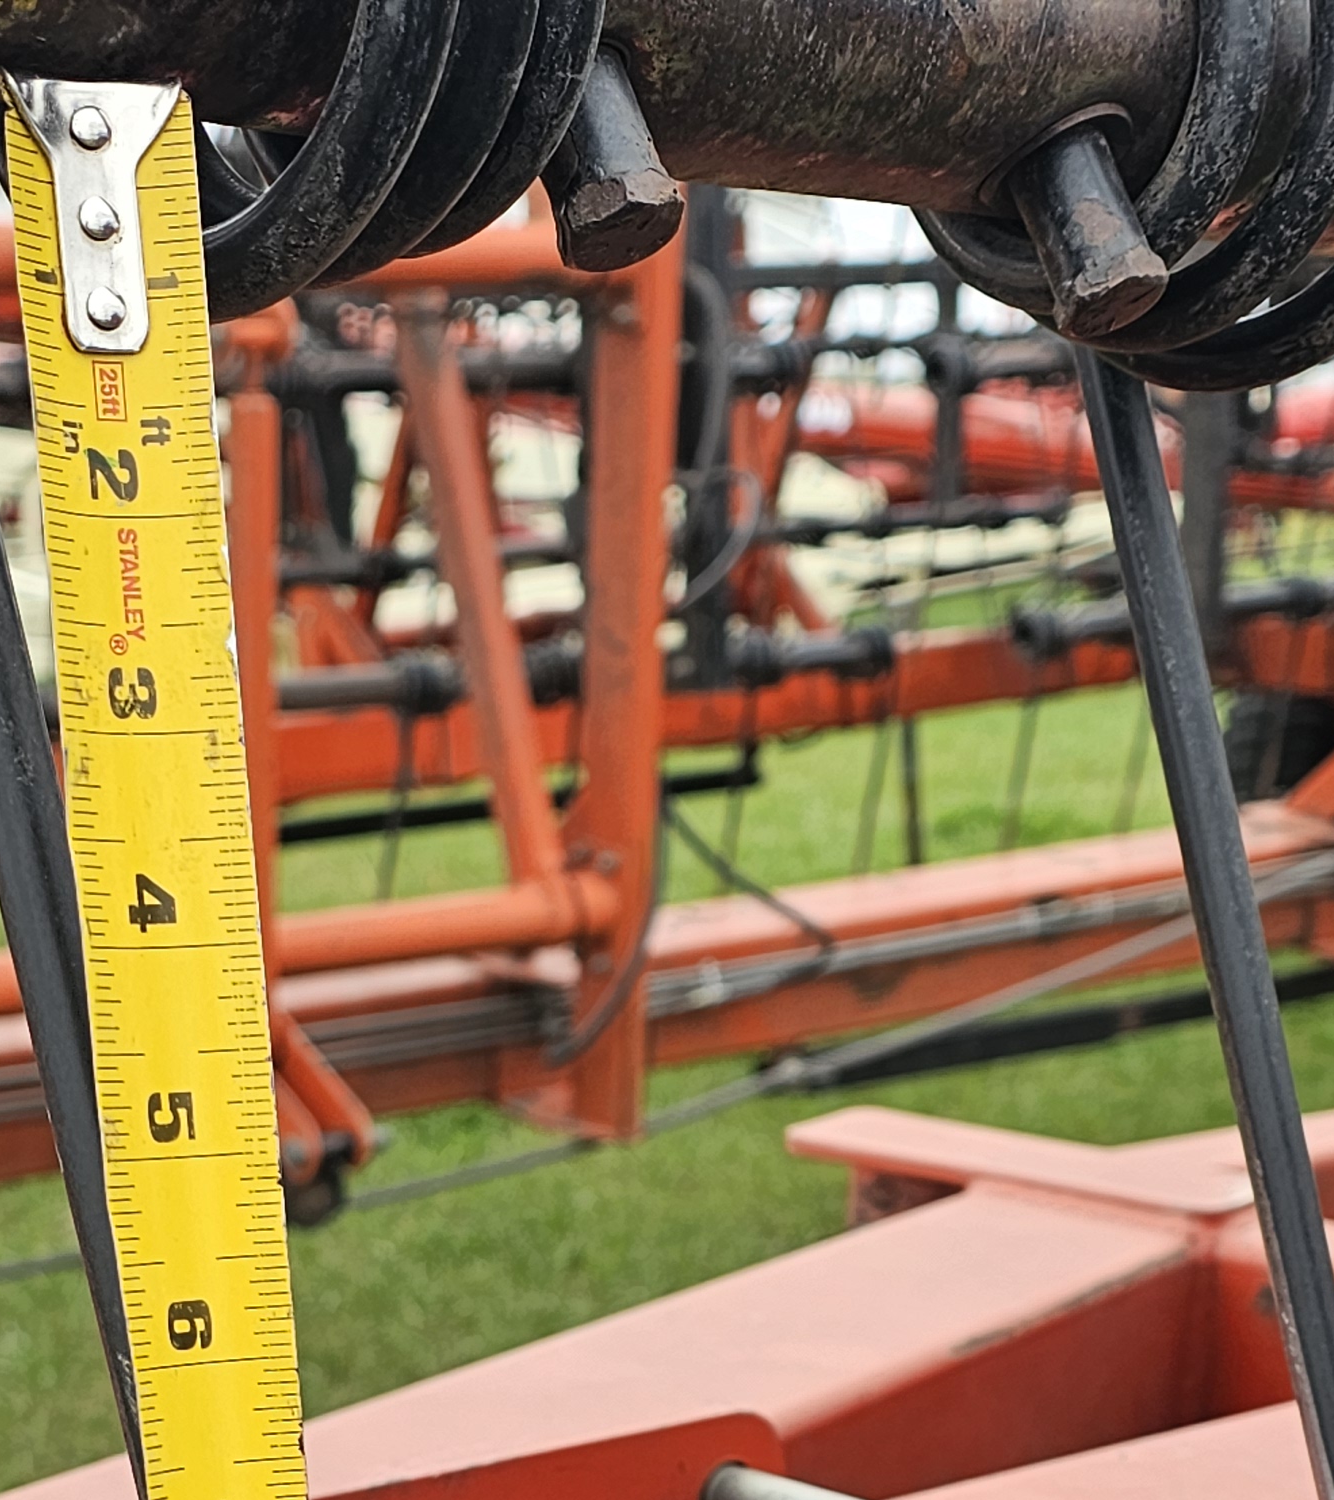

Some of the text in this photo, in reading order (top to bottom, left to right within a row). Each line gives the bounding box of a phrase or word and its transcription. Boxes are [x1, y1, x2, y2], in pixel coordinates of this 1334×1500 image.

[98, 367, 121, 417] 25ft
[140, 415, 172, 447] ft
[85, 448, 140, 503] 2
[108, 667, 157, 720] 3
[128, 873, 177, 933] 4
[147, 1091, 196, 1143] 5
[167, 1299, 213, 1351] 6
